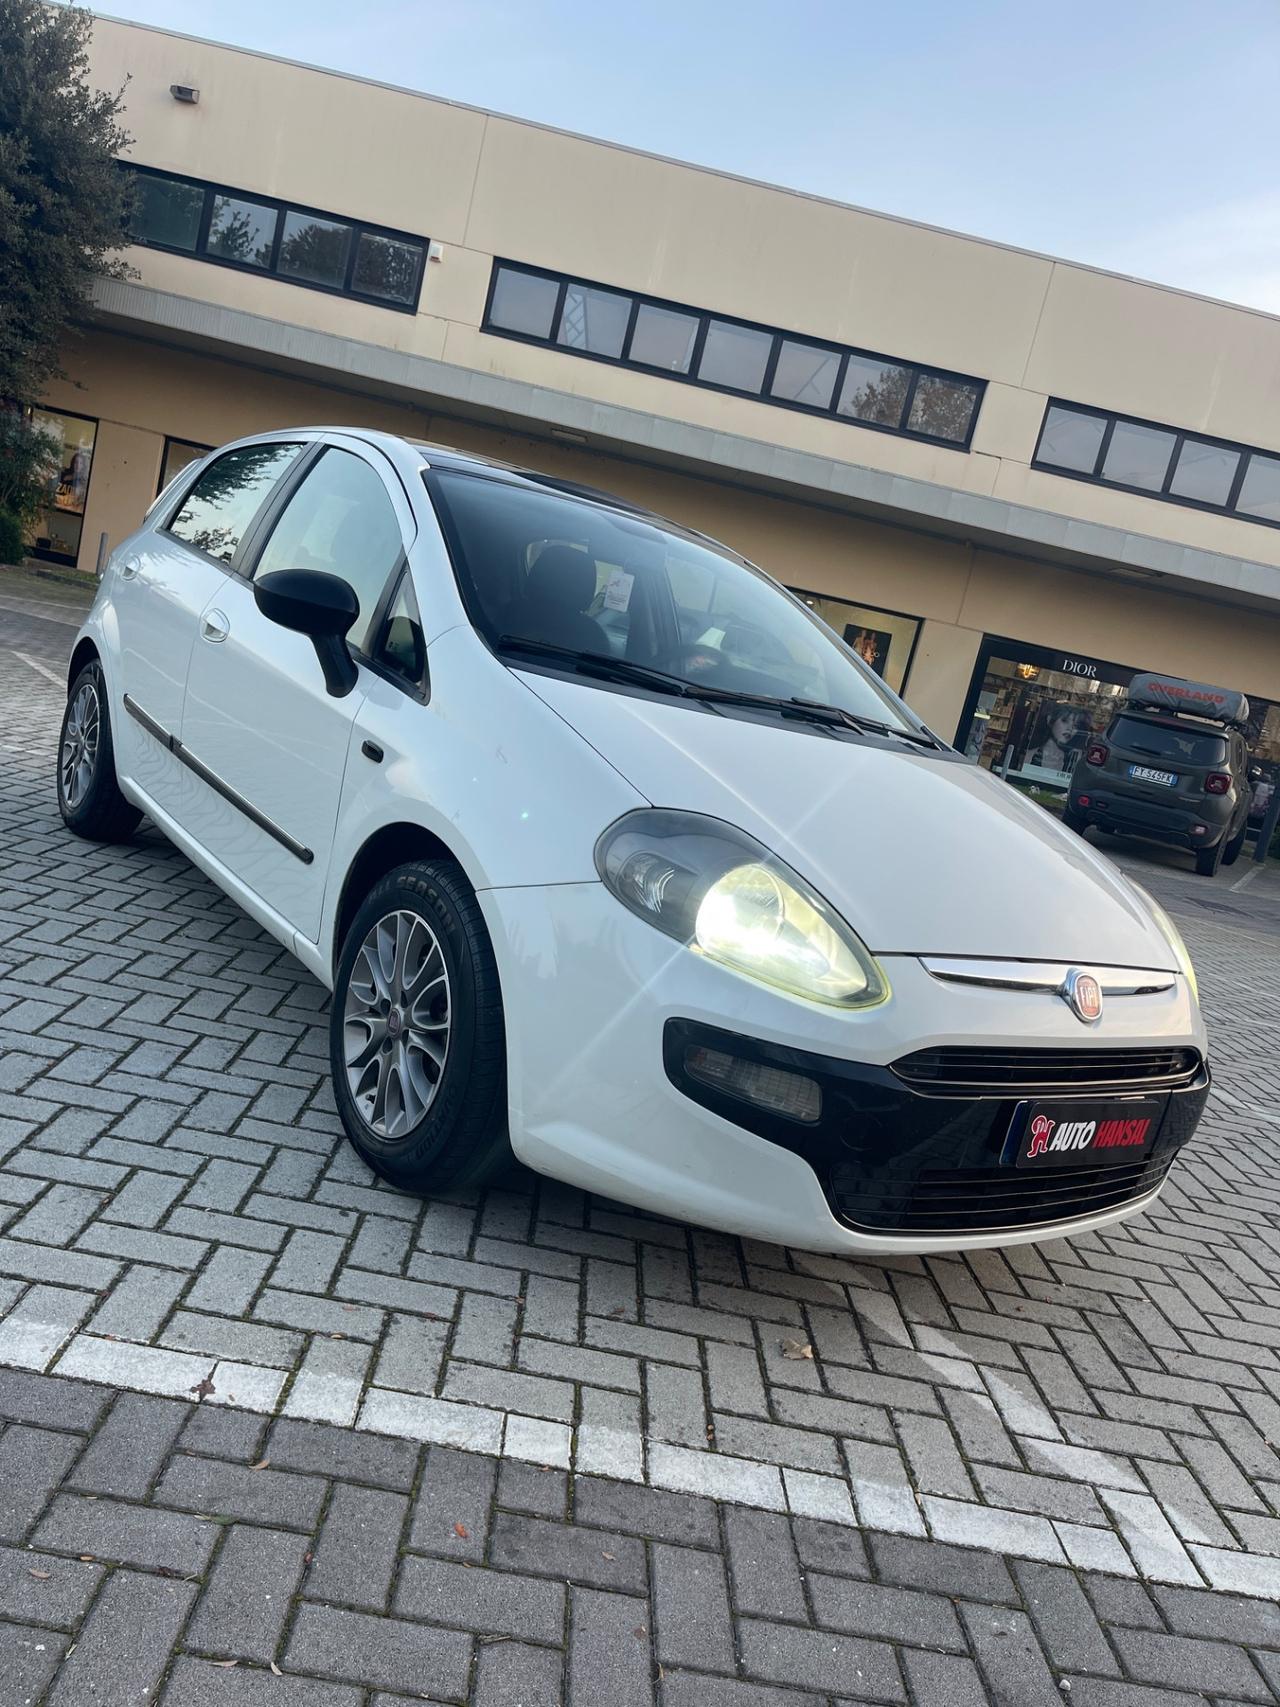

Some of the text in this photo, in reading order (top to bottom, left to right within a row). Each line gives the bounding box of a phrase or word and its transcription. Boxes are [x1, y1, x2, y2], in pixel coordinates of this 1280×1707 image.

[1063, 659, 1097, 678] DIOR
[1048, 1119, 1151, 1152] AUTO HANSAL
